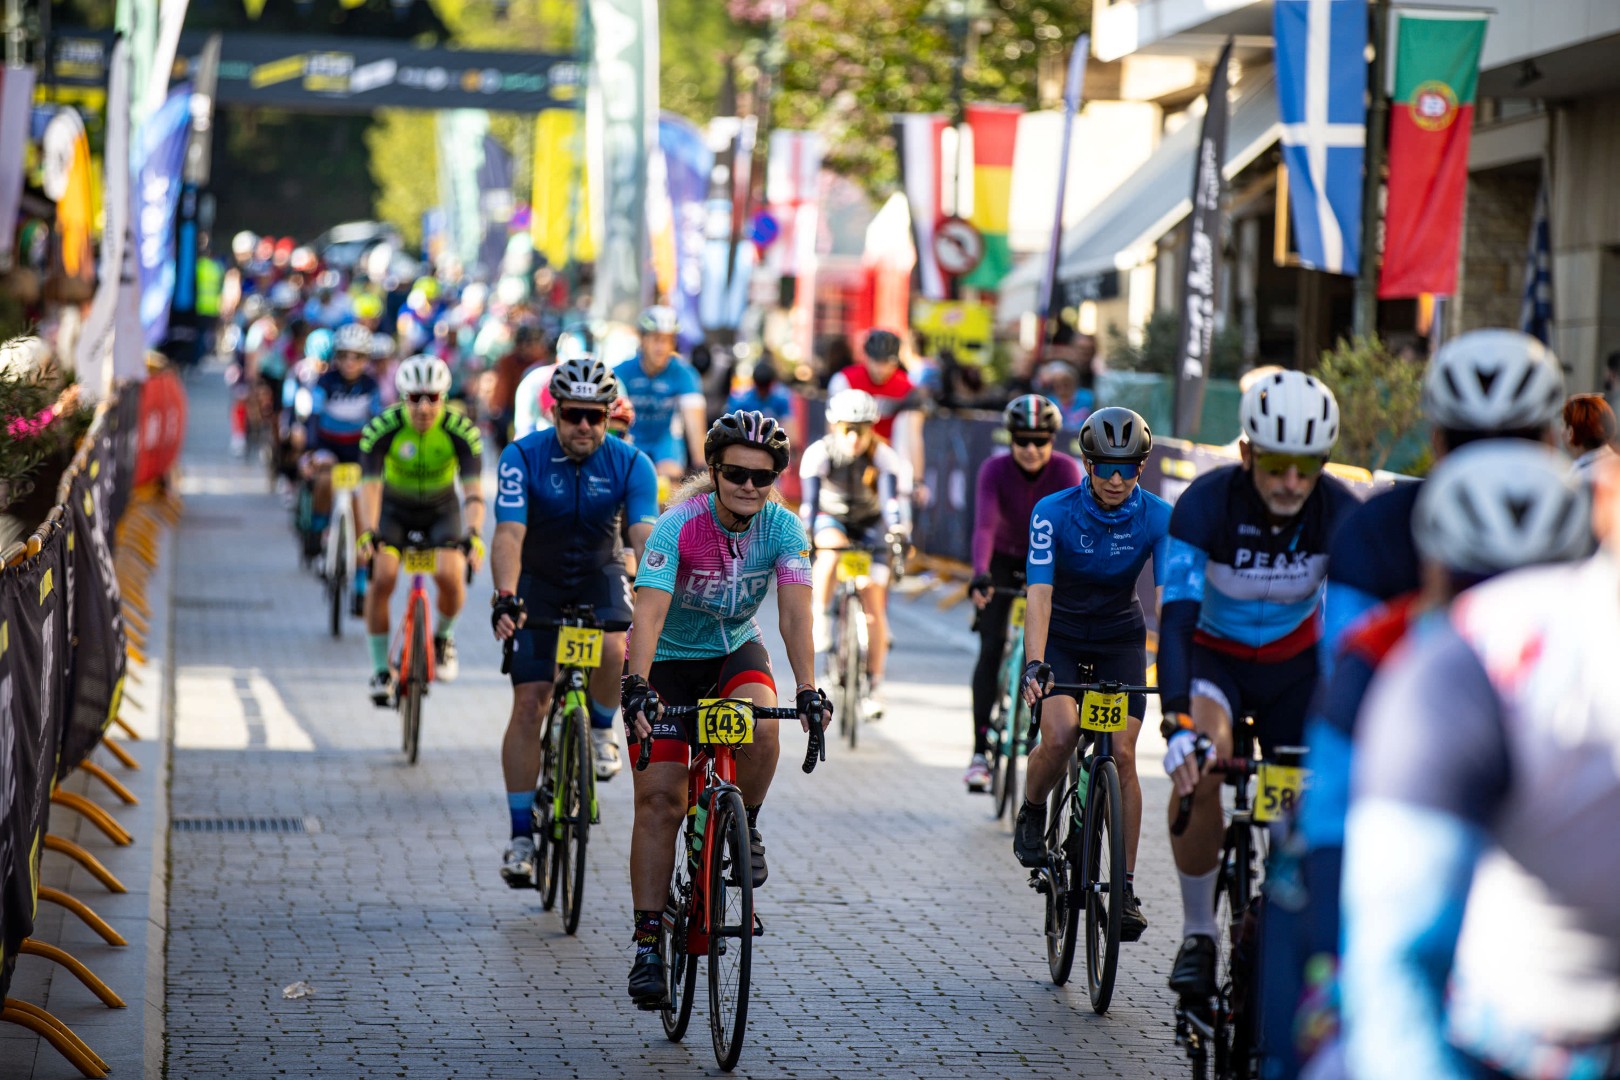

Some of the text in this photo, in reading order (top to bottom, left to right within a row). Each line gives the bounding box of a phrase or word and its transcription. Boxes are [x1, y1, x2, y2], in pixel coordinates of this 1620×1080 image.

[575, 384, 593, 394] 511
[498, 462, 525, 508] CGS
[1029, 513, 1054, 565] CGS
[1234, 547, 1308, 570] PEAK
[565, 640, 594, 660] 511
[706, 713, 745, 735] 343
[1088, 704, 1122, 725] 338
[1264, 786, 1298, 812] 58
